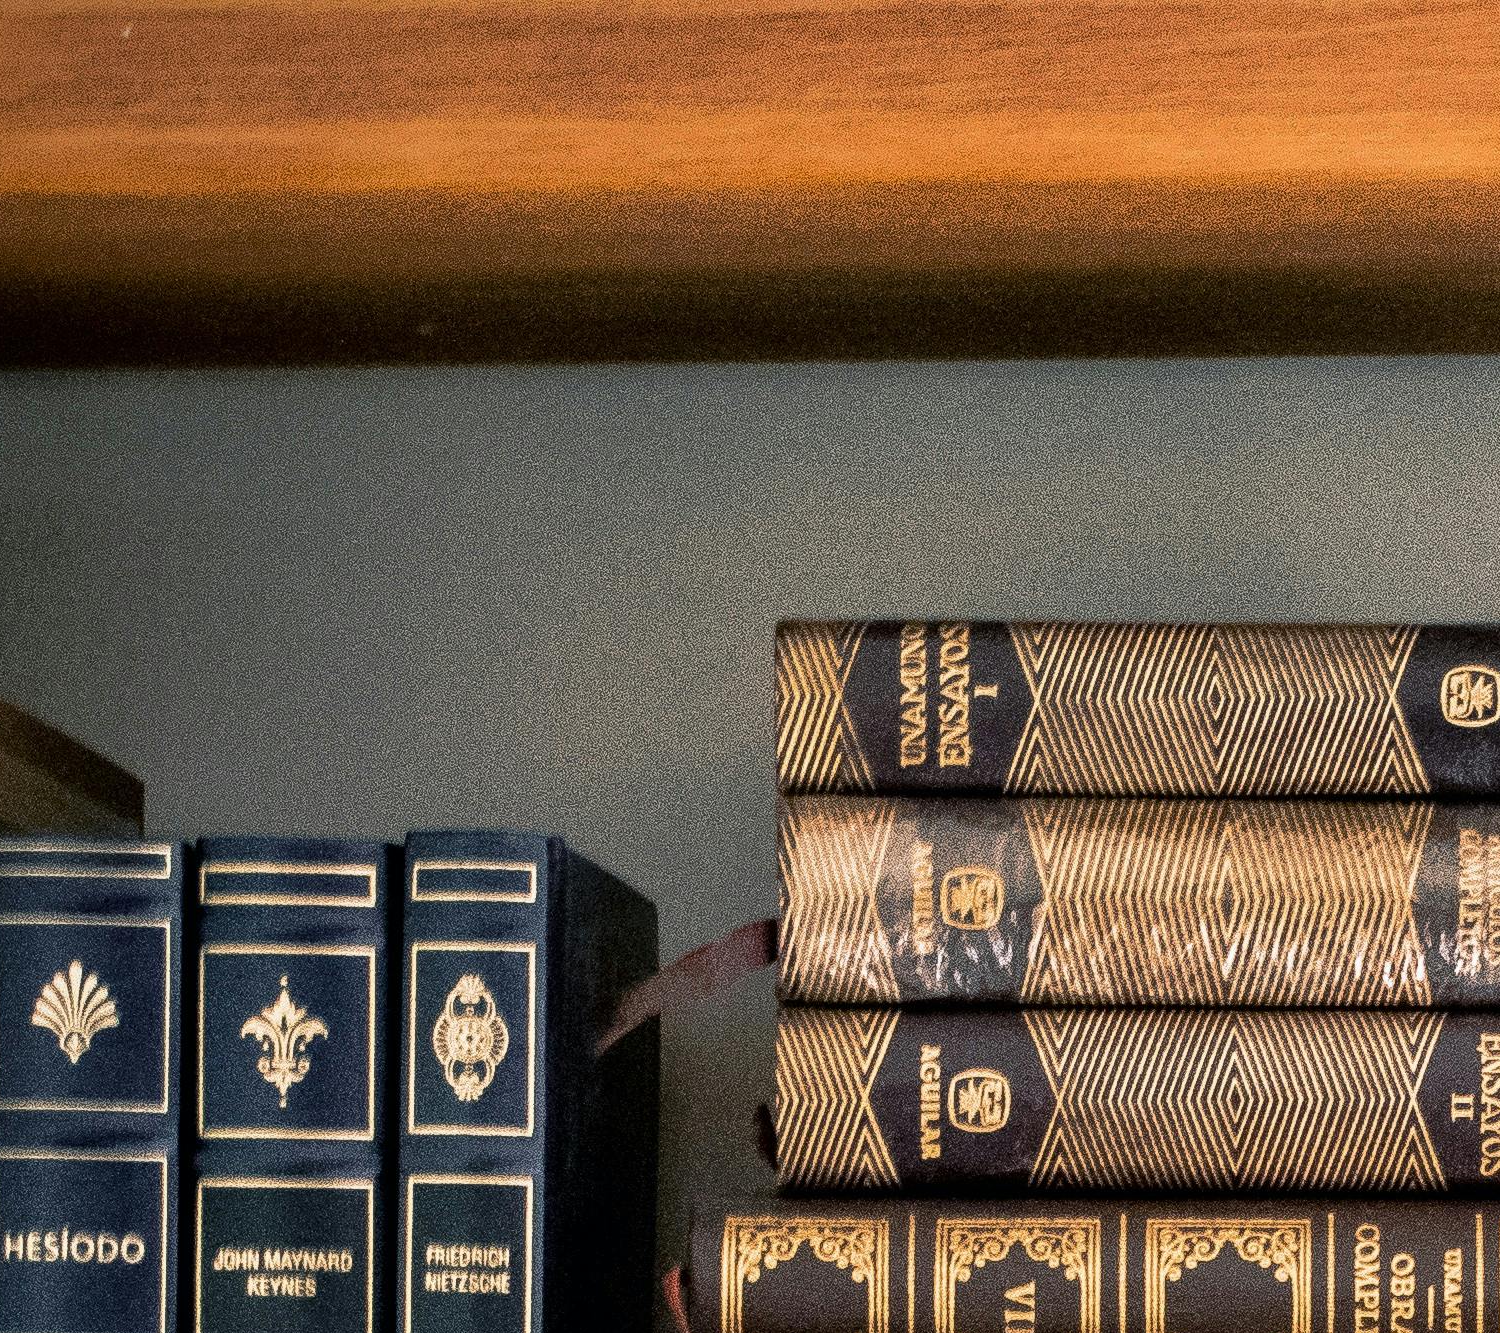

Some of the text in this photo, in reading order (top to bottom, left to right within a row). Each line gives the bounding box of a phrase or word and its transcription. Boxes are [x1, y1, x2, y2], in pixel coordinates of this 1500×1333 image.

[974, 684, 998, 698] I
[919, 1044, 941, 1159] AGUILAR
[1451, 1093, 1474, 1121] II
[4, 1227, 145, 1264] HESÍODO
[426, 1244, 510, 1268] FRIEDRICH
[213, 1248, 353, 1272] JOHN MAYNARD
[246, 1274, 316, 1297] KEYNES
[424, 1270, 510, 1294] NIETZSCHE
